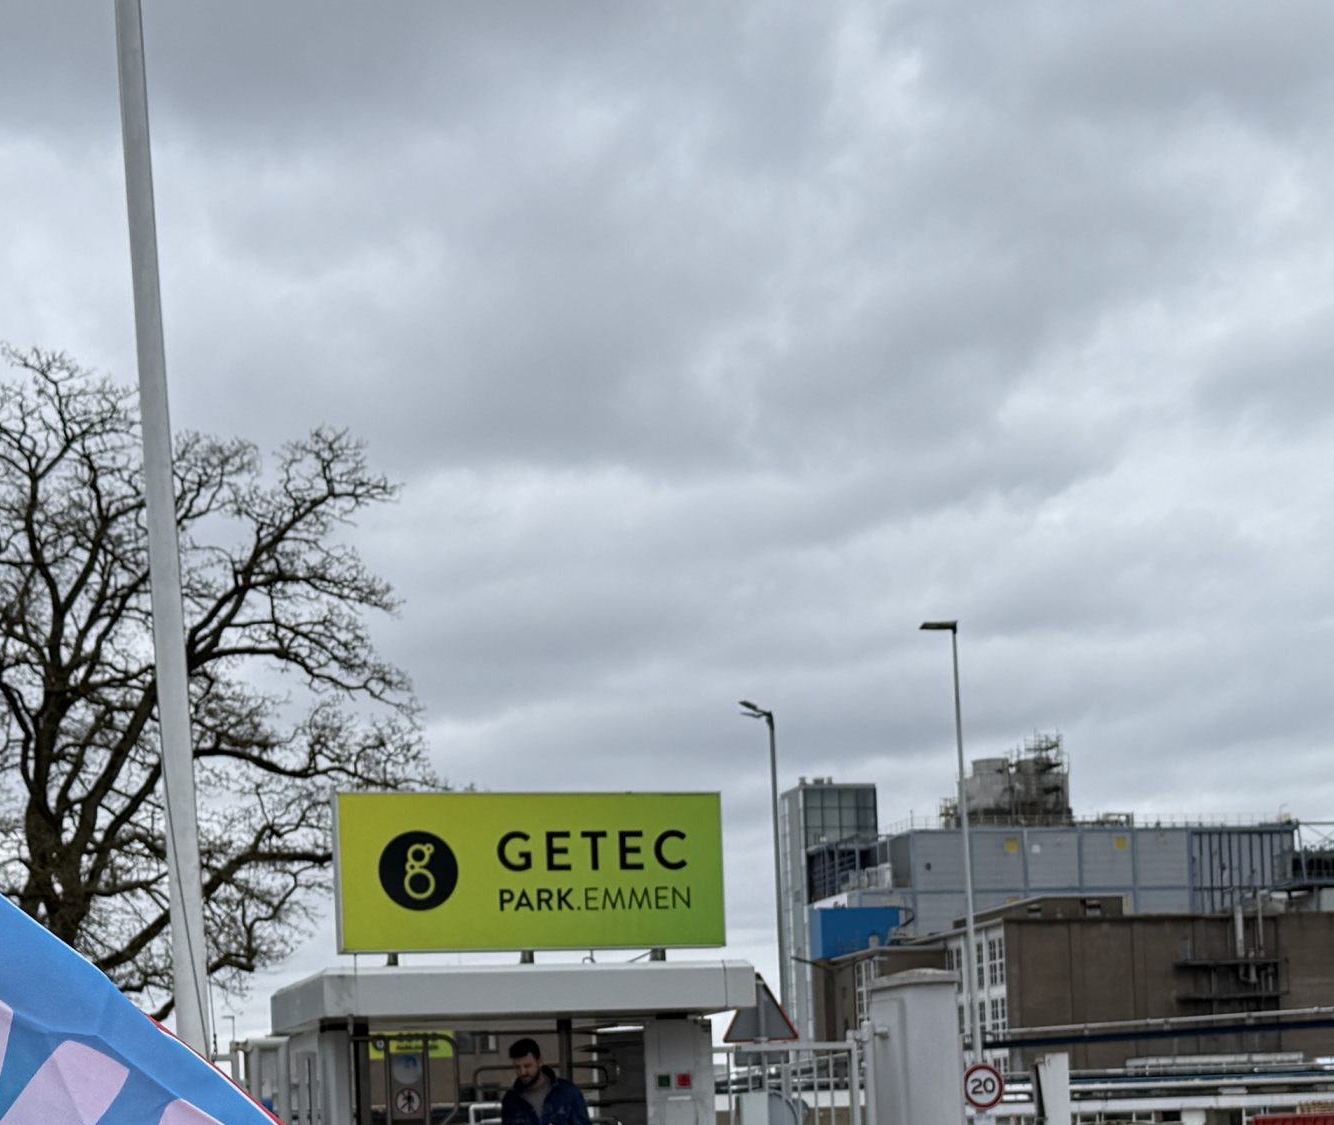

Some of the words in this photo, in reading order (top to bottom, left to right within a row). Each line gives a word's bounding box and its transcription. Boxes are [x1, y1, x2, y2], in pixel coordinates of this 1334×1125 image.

[497, 829, 688, 872] GETEC
[498, 886, 692, 912] PARK.EMMEN
[970, 1077, 996, 1095] 20
